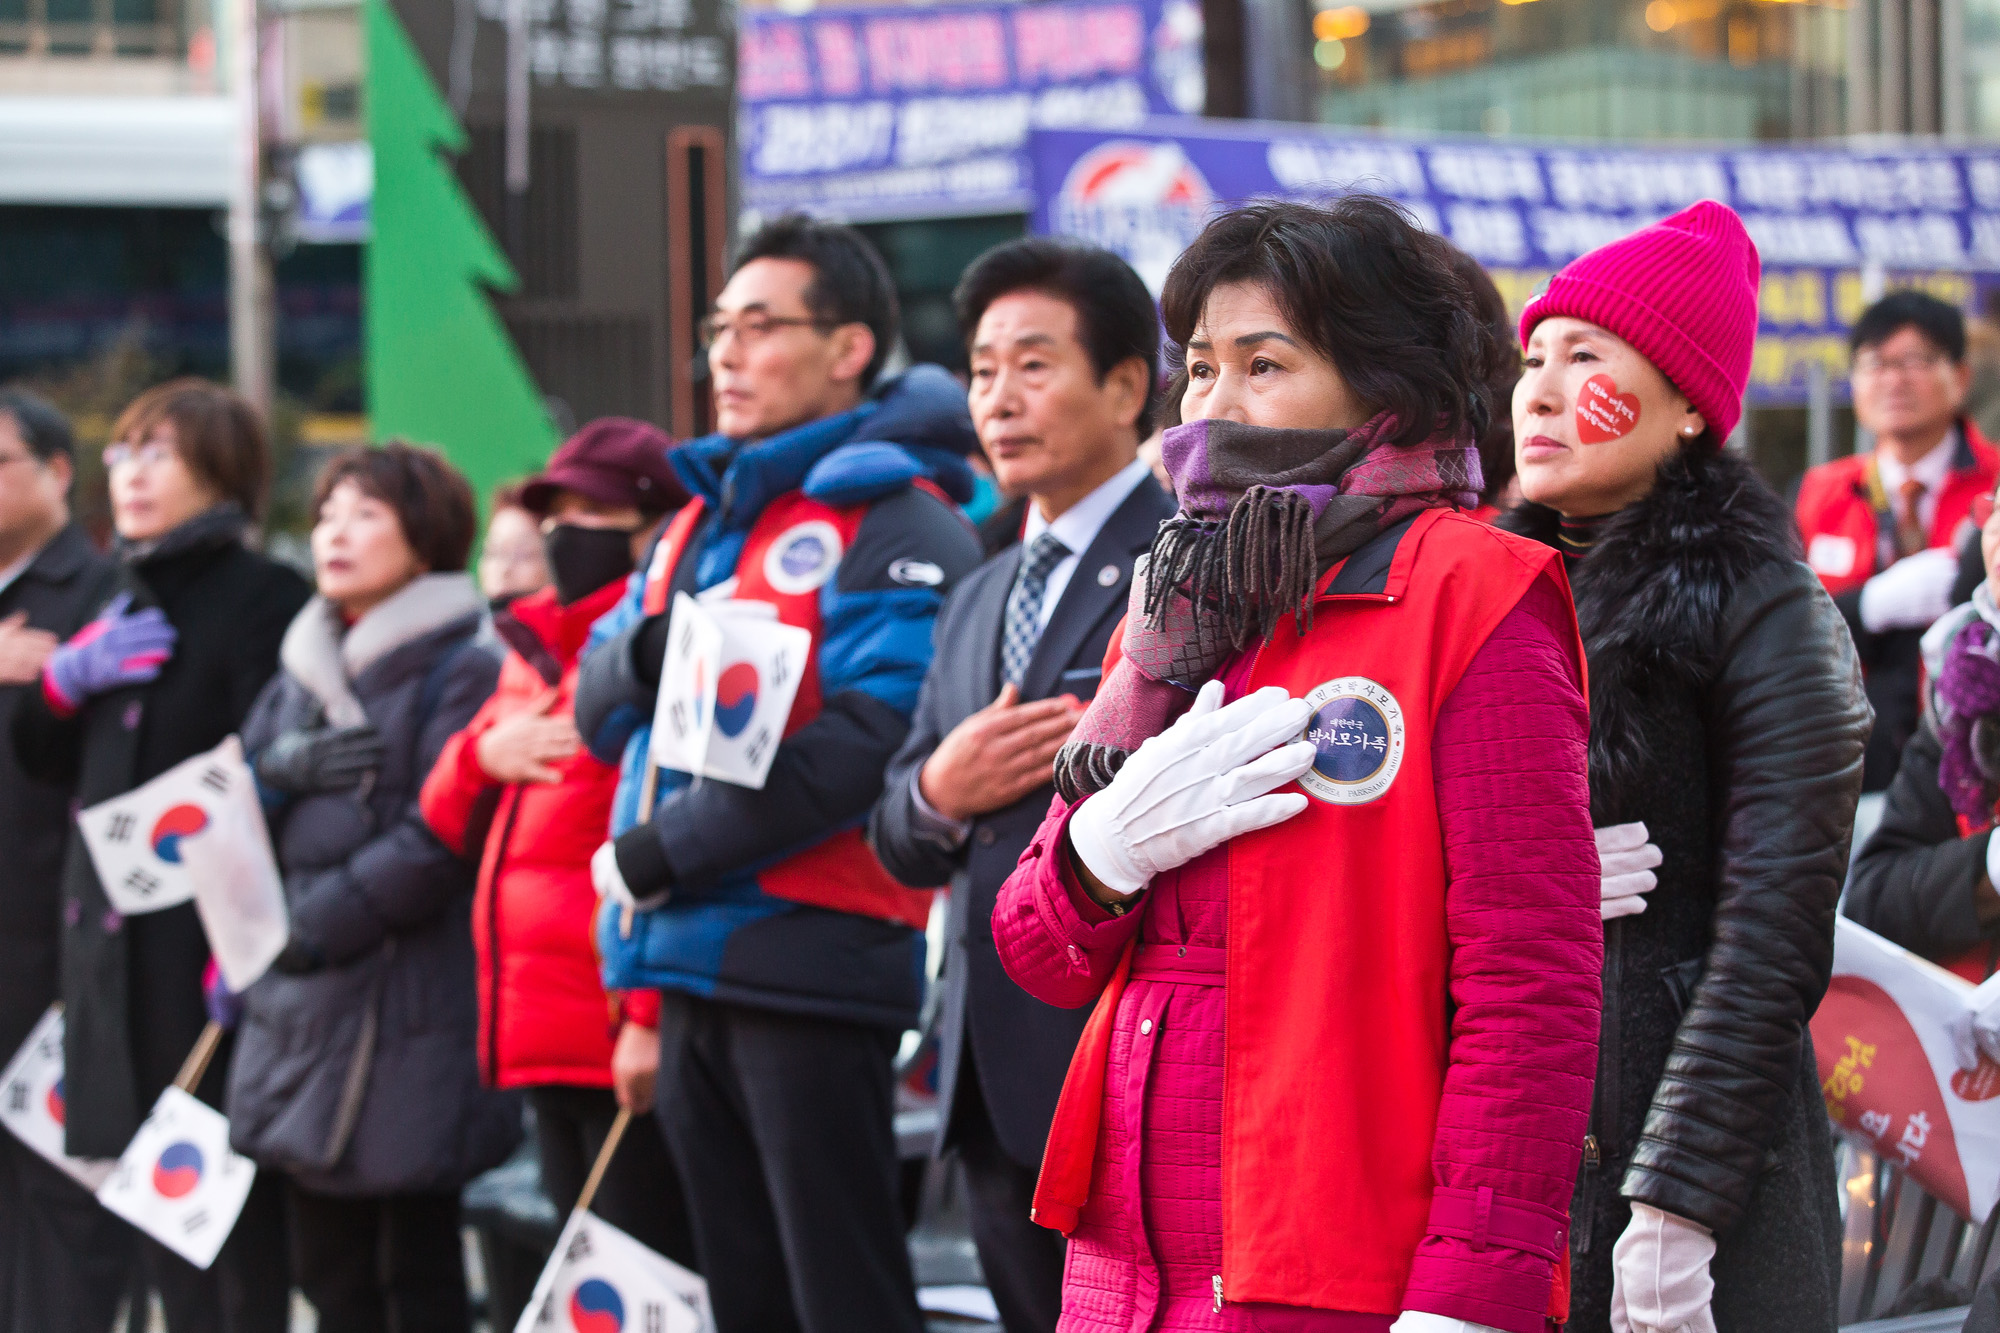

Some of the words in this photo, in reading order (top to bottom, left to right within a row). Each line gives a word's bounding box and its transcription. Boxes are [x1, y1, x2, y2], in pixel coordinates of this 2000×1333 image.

[1329, 718, 1364, 730] 대한민국
[1308, 728, 1387, 753] 박사모가족
[1315, 782, 1341, 798] KOREA
[1387, 750, 1400, 779] FAMILY
